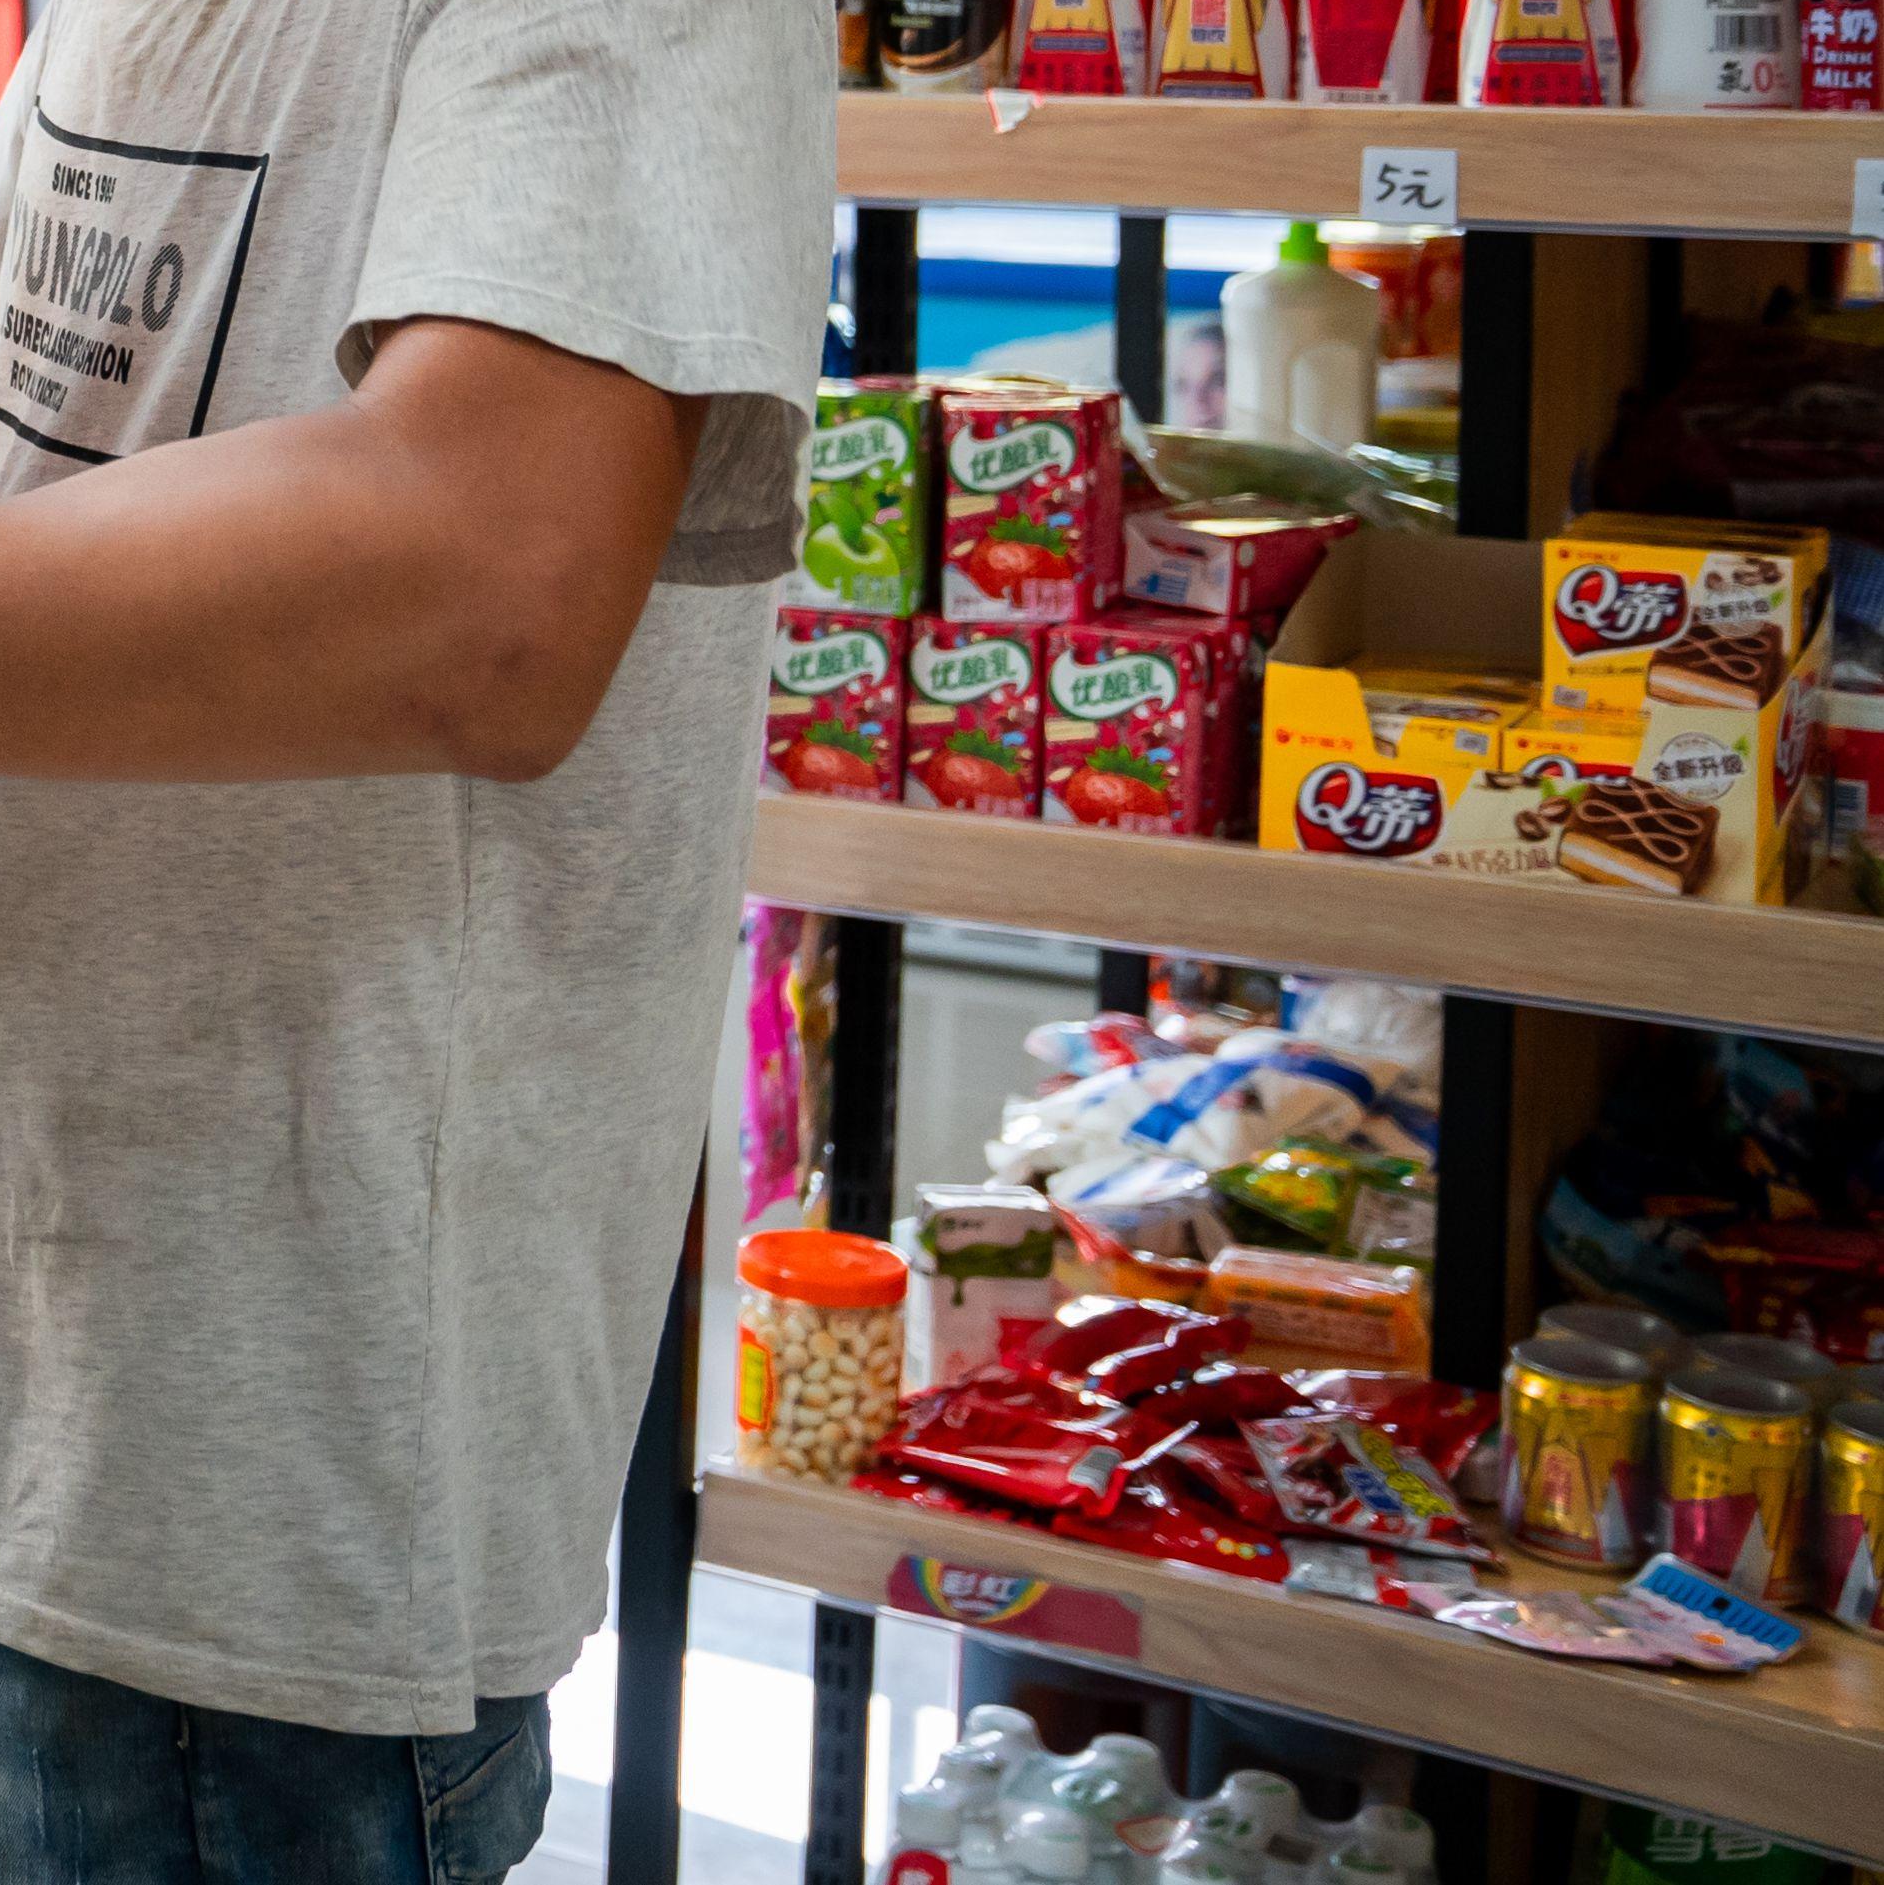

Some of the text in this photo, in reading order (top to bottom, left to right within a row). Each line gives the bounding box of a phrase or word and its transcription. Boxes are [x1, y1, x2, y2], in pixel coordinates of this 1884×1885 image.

[1814, 67, 1873, 88] MILK
[52, 162, 93, 200] SINCE
[1376, 163, 1445, 210] 5元
[969, 432, 1059, 481] 优酸乳
[1072, 668, 1162, 707] 优酸乳
